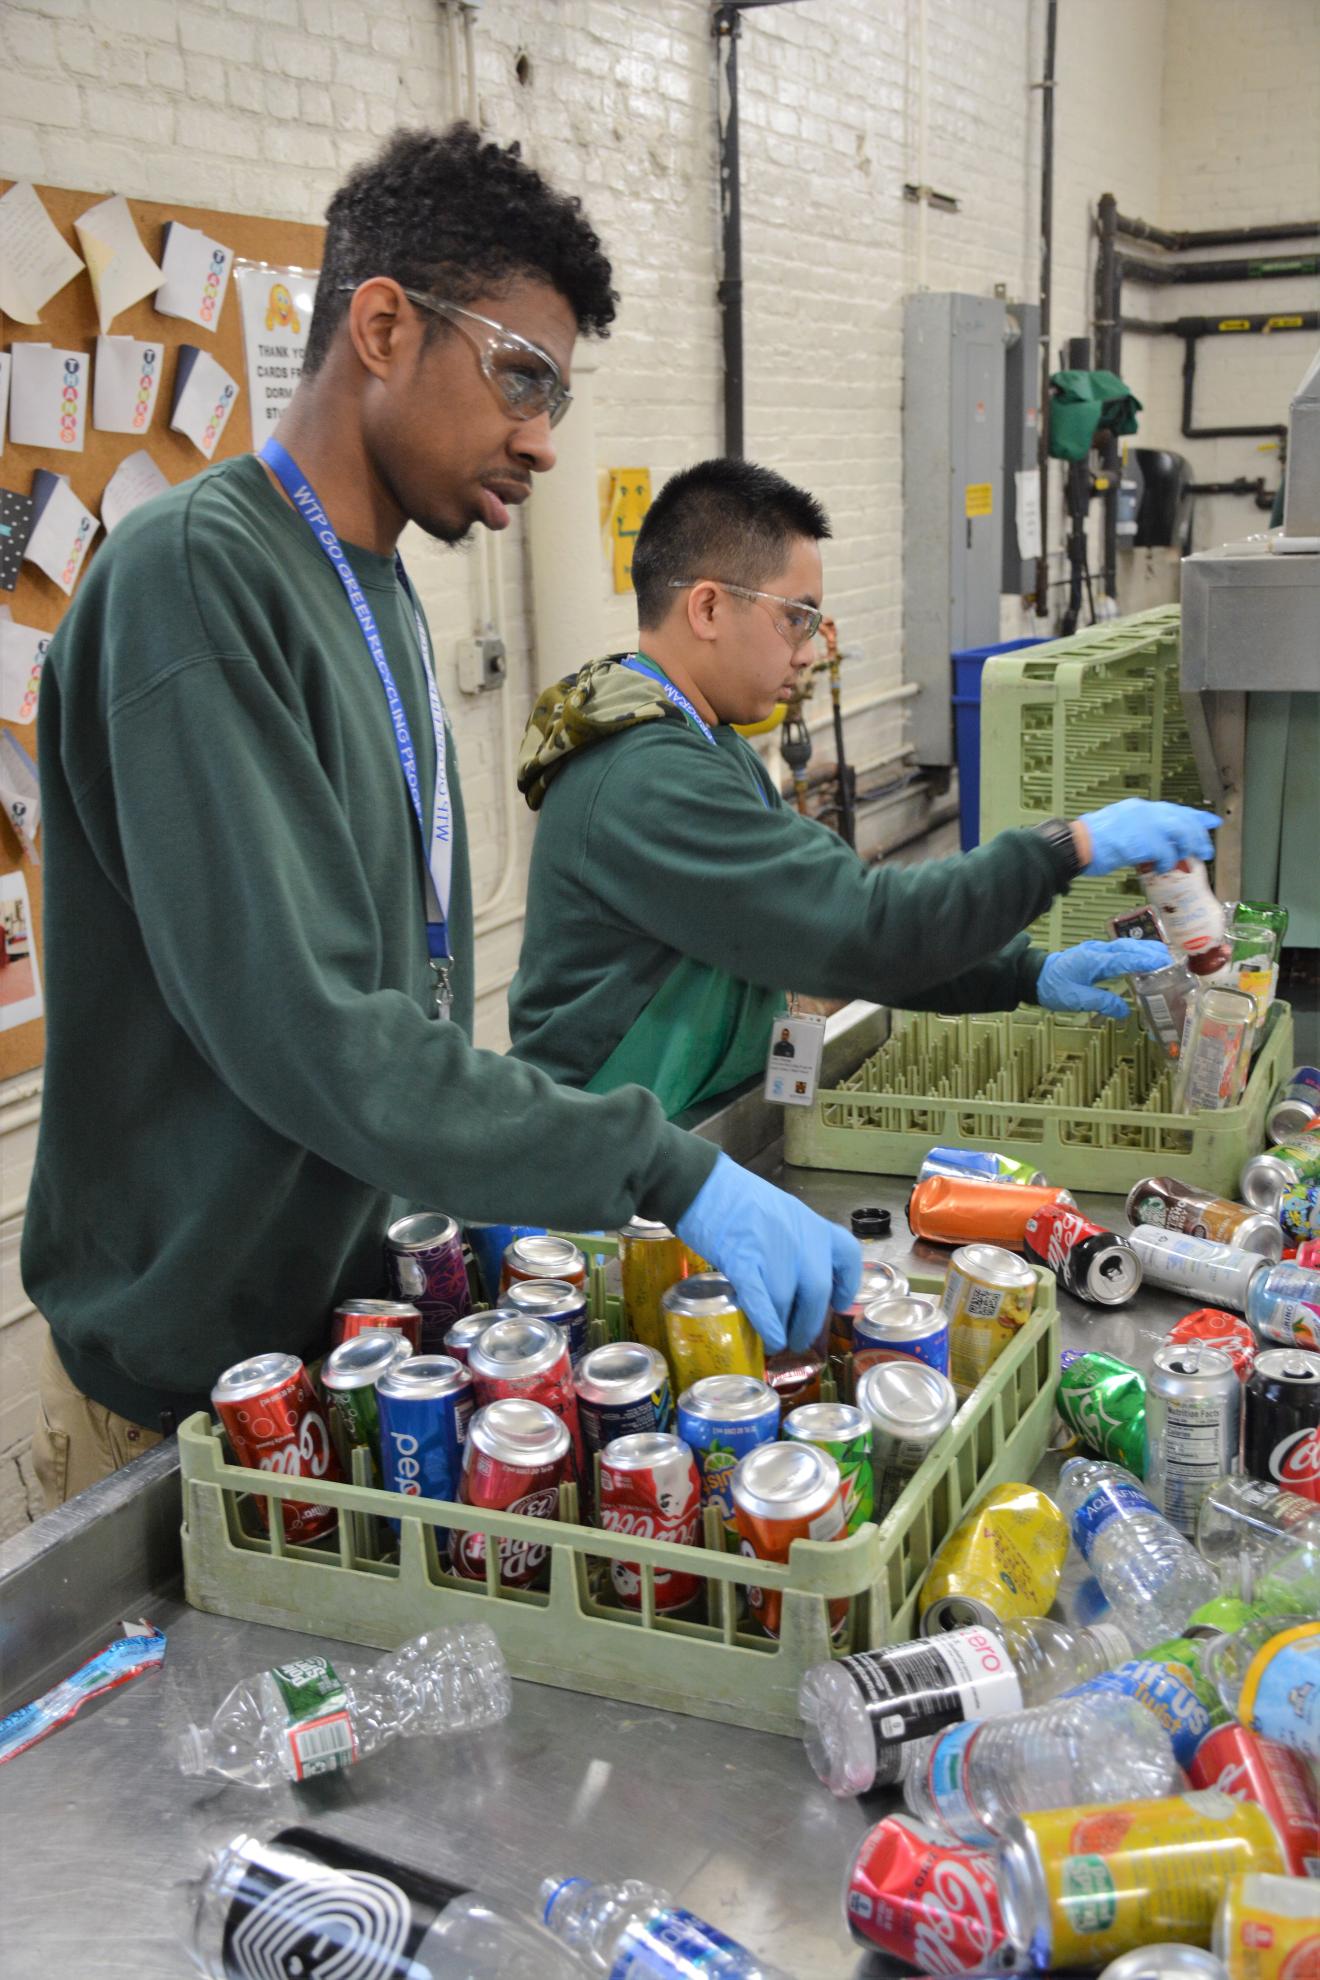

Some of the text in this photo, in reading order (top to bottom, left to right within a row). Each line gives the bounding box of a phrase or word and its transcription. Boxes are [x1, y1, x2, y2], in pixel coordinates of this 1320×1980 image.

[199, 248, 225, 323] THANKS
[257, 366, 288, 380] CARDS
[259, 344, 288, 358] THANK
[61, 356, 81, 444] THANKS
[131, 347, 157, 430] THANKS
[265, 387, 293, 401] DORM
[294, 485, 327, 526] WTP
[319, 529, 343, 560] GO
[367, 634, 411, 744] RECYCLING
[1117, 1661, 1209, 1734] citrus
